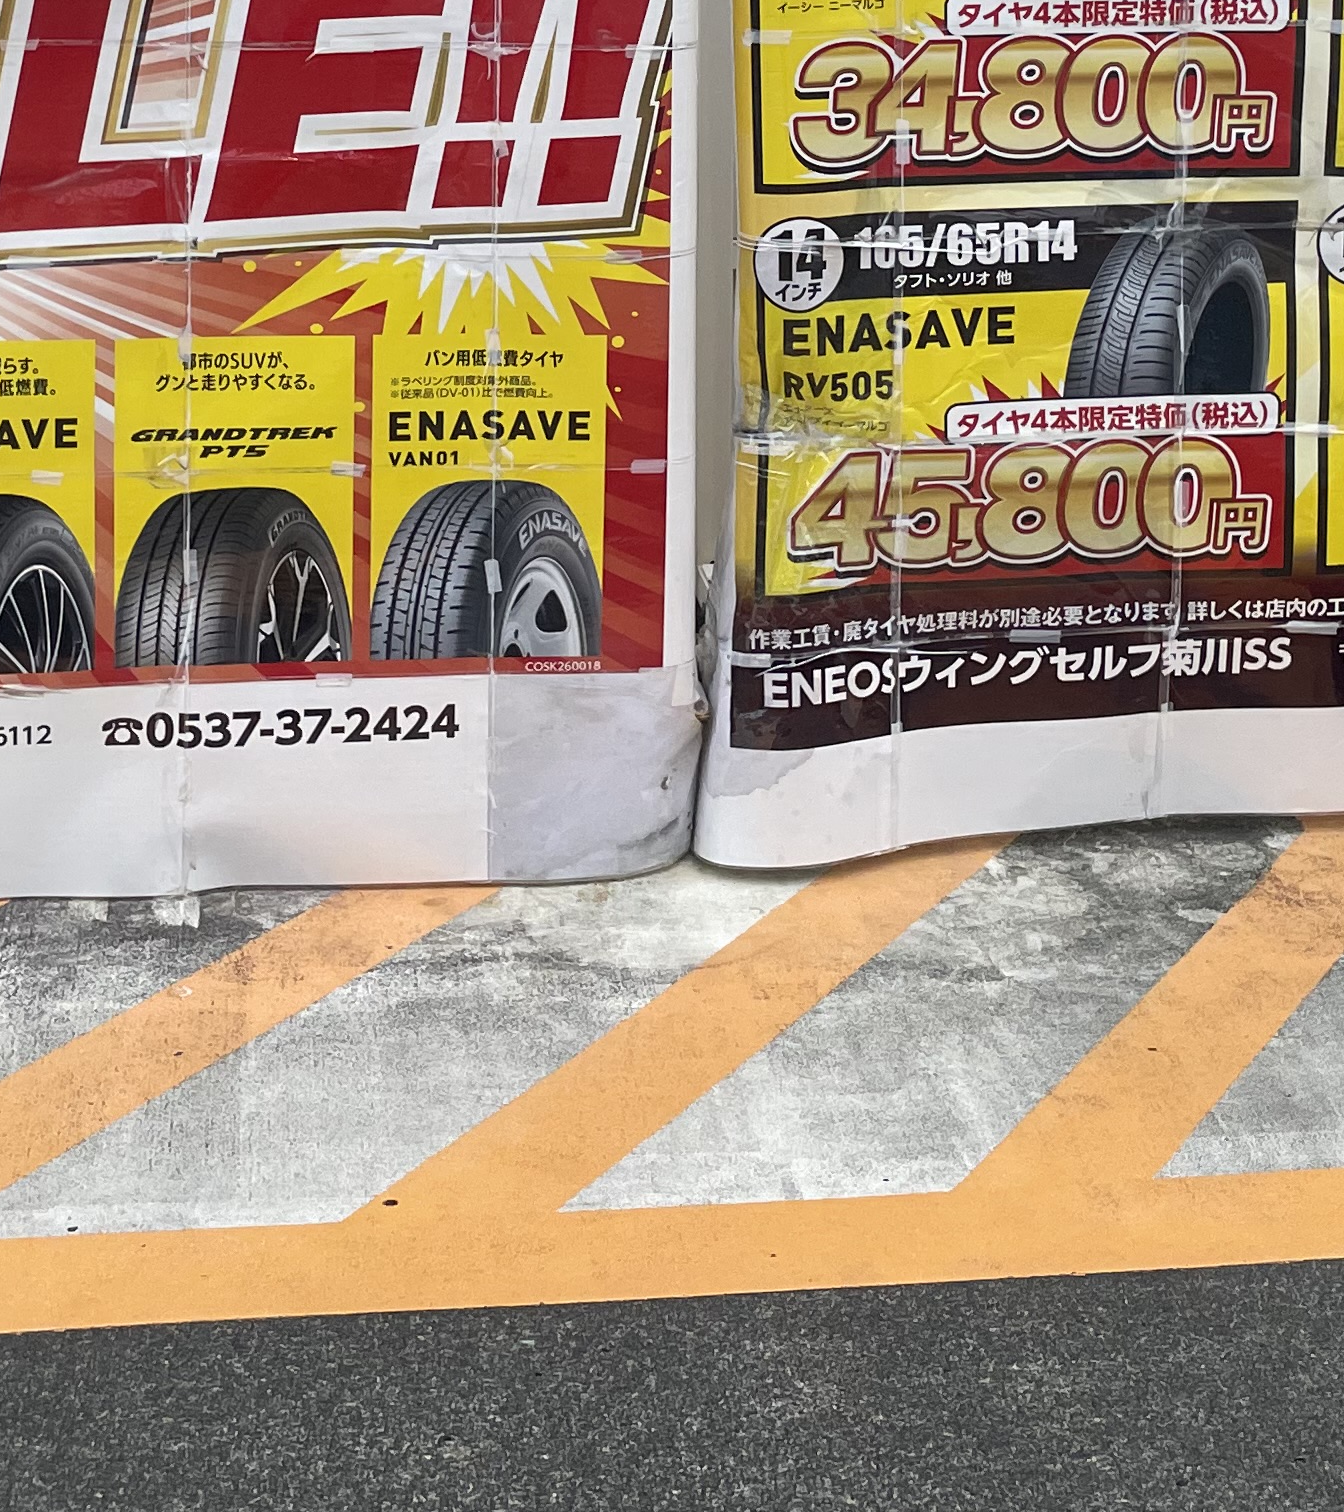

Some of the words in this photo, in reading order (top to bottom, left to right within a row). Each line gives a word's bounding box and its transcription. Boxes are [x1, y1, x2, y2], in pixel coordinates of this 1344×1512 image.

[777, 1, 824, 13] イーシー
[795, 34, 1274, 164] 34,800円
[770, 228, 827, 282] 14
[775, 282, 823, 302] インチ
[996, 270, 1011, 286] 他
[783, 306, 1015, 357] ENASAVE
[424, 349, 563, 368] バン用低費タイヤ
[156, 374, 315, 392] グンと走りやすくなる。
[783, 370, 894, 402] RV505
[131, 426, 338, 442] GRANDTREK
[389, 410, 590, 441] ENASAVE
[956, 401, 1269, 438] タイヤ4本限定特価(税込)
[200, 445, 270, 458] PT5
[389, 451, 459, 467] VAN01
[790, 438, 1268, 571] 45,800円
[519, 511, 587, 558] ENASAVE
[525, 661, 601, 673] COSK260018
[764, 636, 1292, 708] ENEOSウィングセルフ菊川SS
